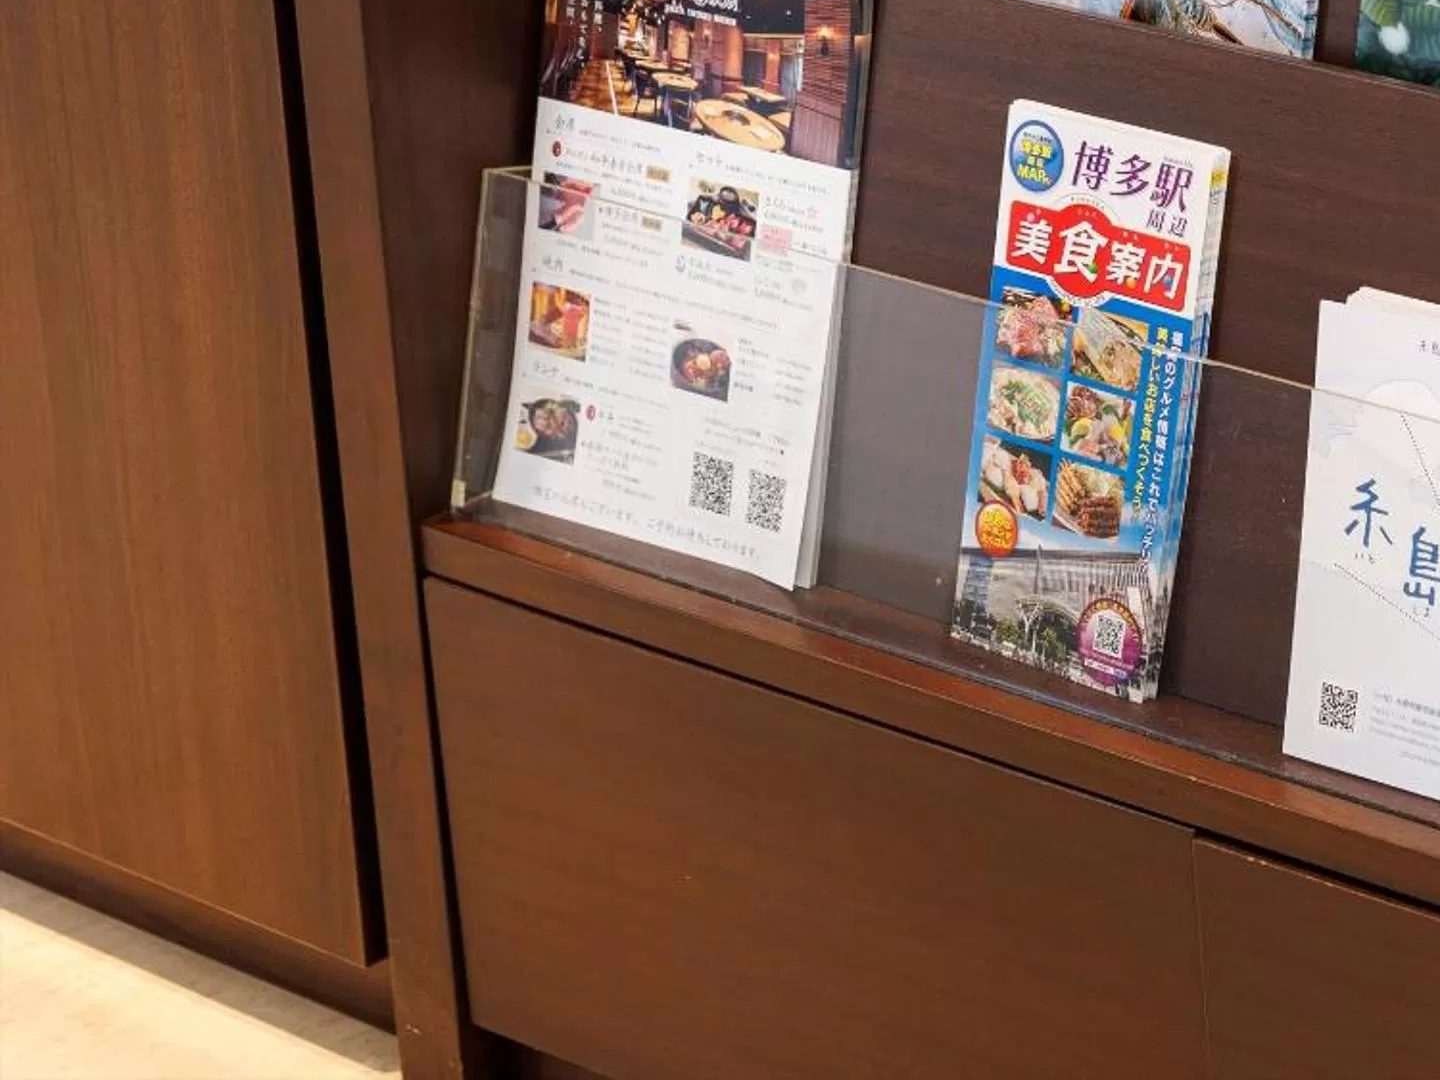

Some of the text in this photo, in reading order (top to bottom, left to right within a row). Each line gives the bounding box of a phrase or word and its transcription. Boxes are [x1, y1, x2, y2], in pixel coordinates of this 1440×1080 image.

[1071, 139, 1194, 213] 博多駅
[1011, 217, 1185, 301] 美食案内
[1146, 208, 1188, 238] 周辺
